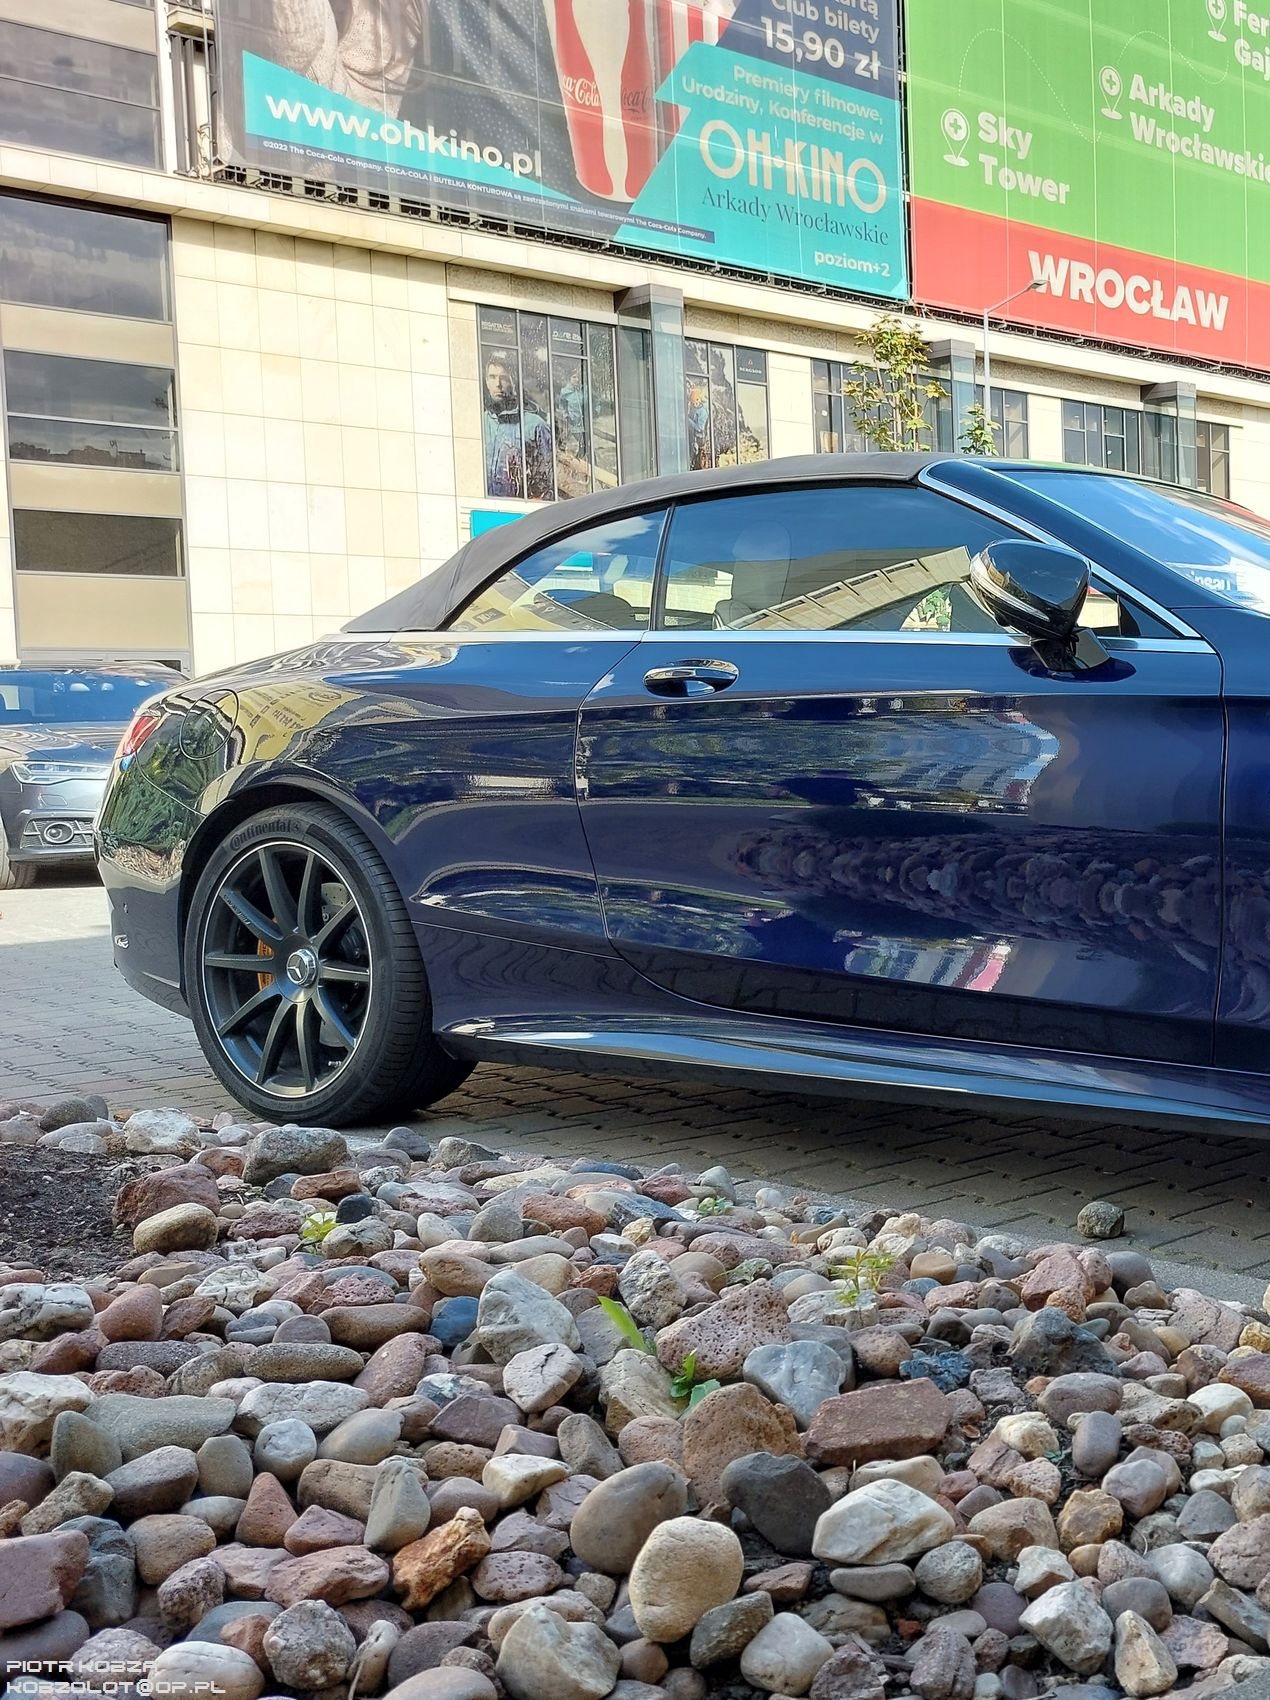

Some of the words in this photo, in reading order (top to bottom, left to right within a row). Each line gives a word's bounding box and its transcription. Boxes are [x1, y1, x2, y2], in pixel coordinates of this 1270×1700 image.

[760, 15, 845, 69] 15,90
[854, 50, 881, 81] zł
[824, 5, 880, 44] bilety
[1233, 38, 1270, 82] Gaj
[681, 75, 764, 116] Urodziny,
[768, 100, 866, 142] Konferencje
[869, 130, 885, 146] w
[733, 64, 810, 101] Premiery
[814, 88, 884, 126] filmowe,
[1129, 73, 1215, 133] Arkady
[265, 94, 543, 178] www.ohkino.pl
[977, 111, 1033, 160] Sky
[289, 145, 305, 156] The
[305, 149, 345, 164] Coca-Cola
[345, 158, 384, 173] Company.
[384, 166, 429, 182] COCA-COLA
[433, 175, 467, 189] BUTELKA
[978, 152, 1071, 205] Tower
[701, 186, 772, 223] Arkady
[774, 202, 890, 246] Wrocławskie
[814, 250, 891, 278] poziom+2
[1027, 249, 1230, 332] WROCŁAW
[229, 819, 291, 851] Continental
